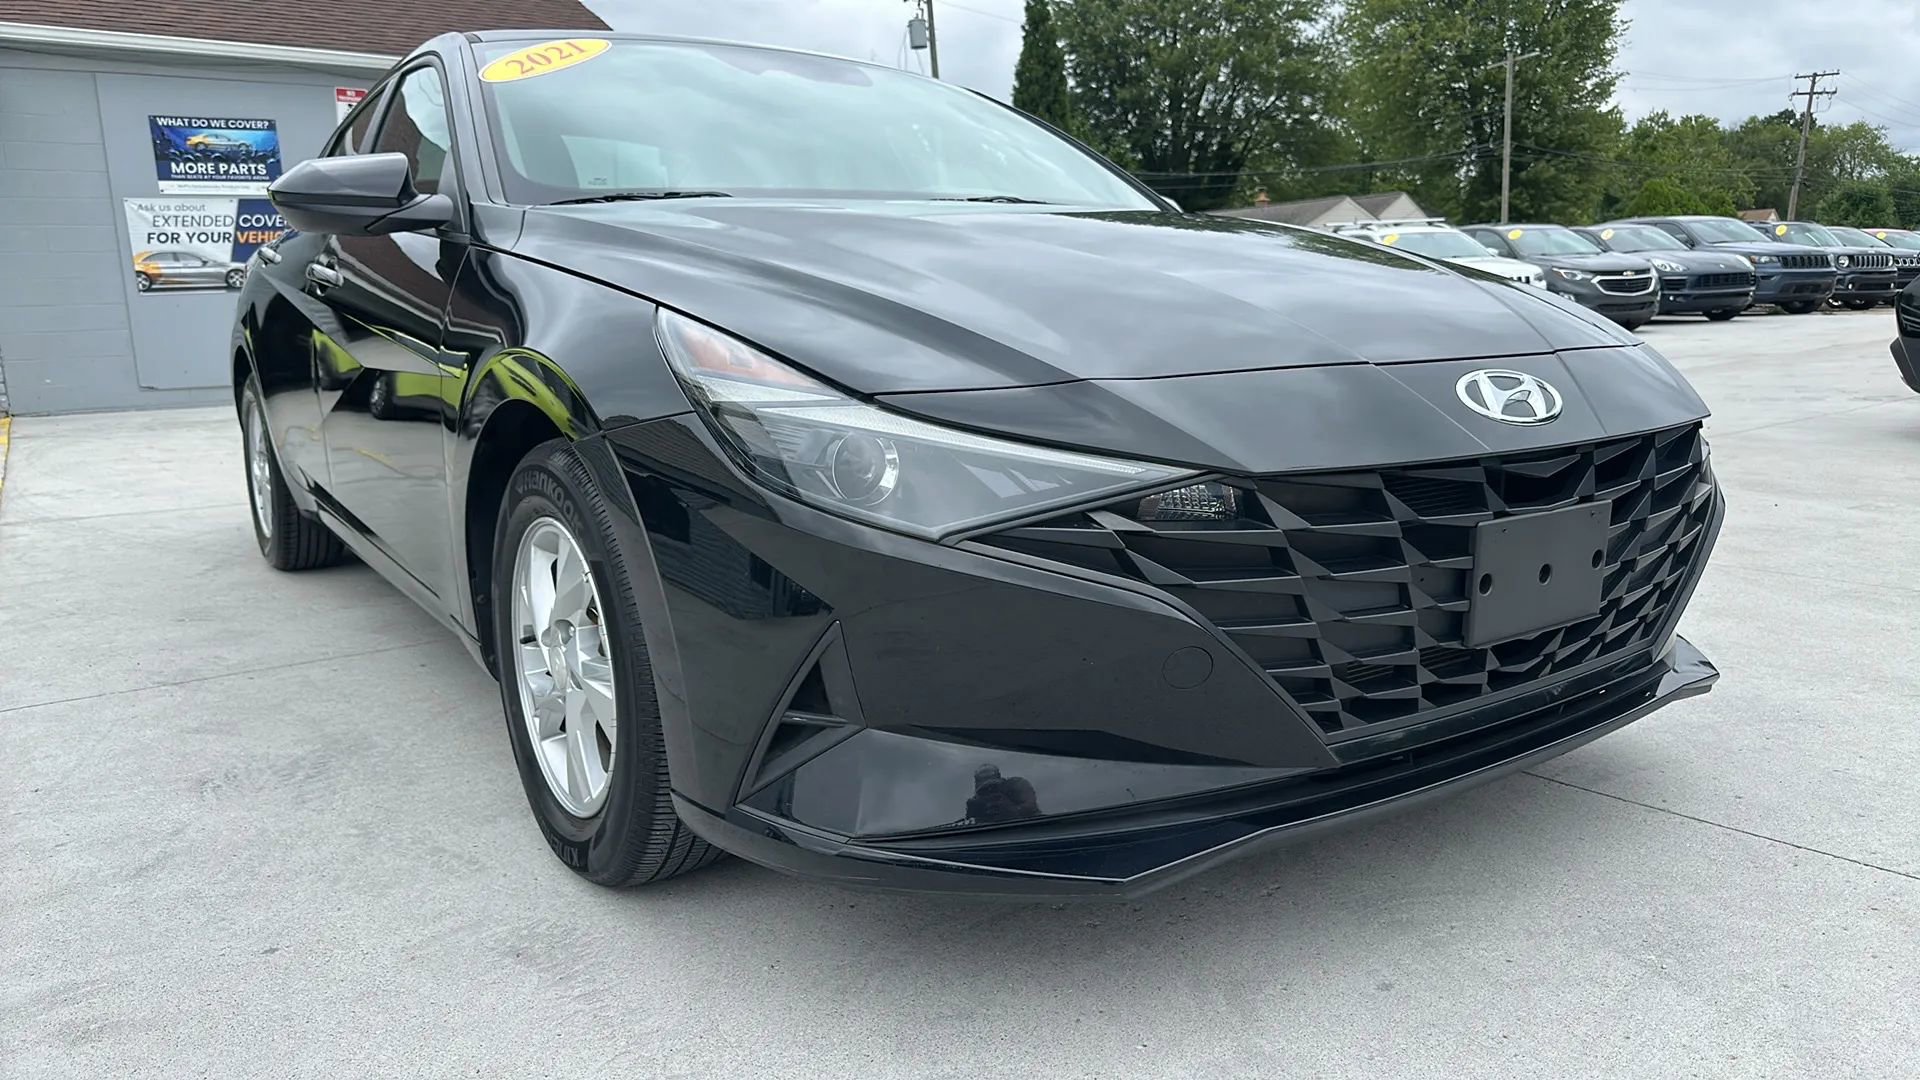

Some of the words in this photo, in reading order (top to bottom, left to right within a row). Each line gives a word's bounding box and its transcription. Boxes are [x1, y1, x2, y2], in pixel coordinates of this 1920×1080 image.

[505, 41, 588, 75] 2021
[156, 117, 190, 127] WHAT
[191, 119, 208, 128] DO
[209, 119, 227, 128] WE
[228, 120, 269, 129] COVER?
[171, 162, 216, 174] MORE
[219, 163, 267, 175] PARTS
[137, 203, 156, 212] Ask
[159, 204, 171, 212] us
[174, 203, 206, 212] about
[152, 215, 234, 228] EXTENDED
[239, 214, 287, 227] COVE
[147, 232, 181, 244] FOR
[186, 232, 232, 244] YOUR
